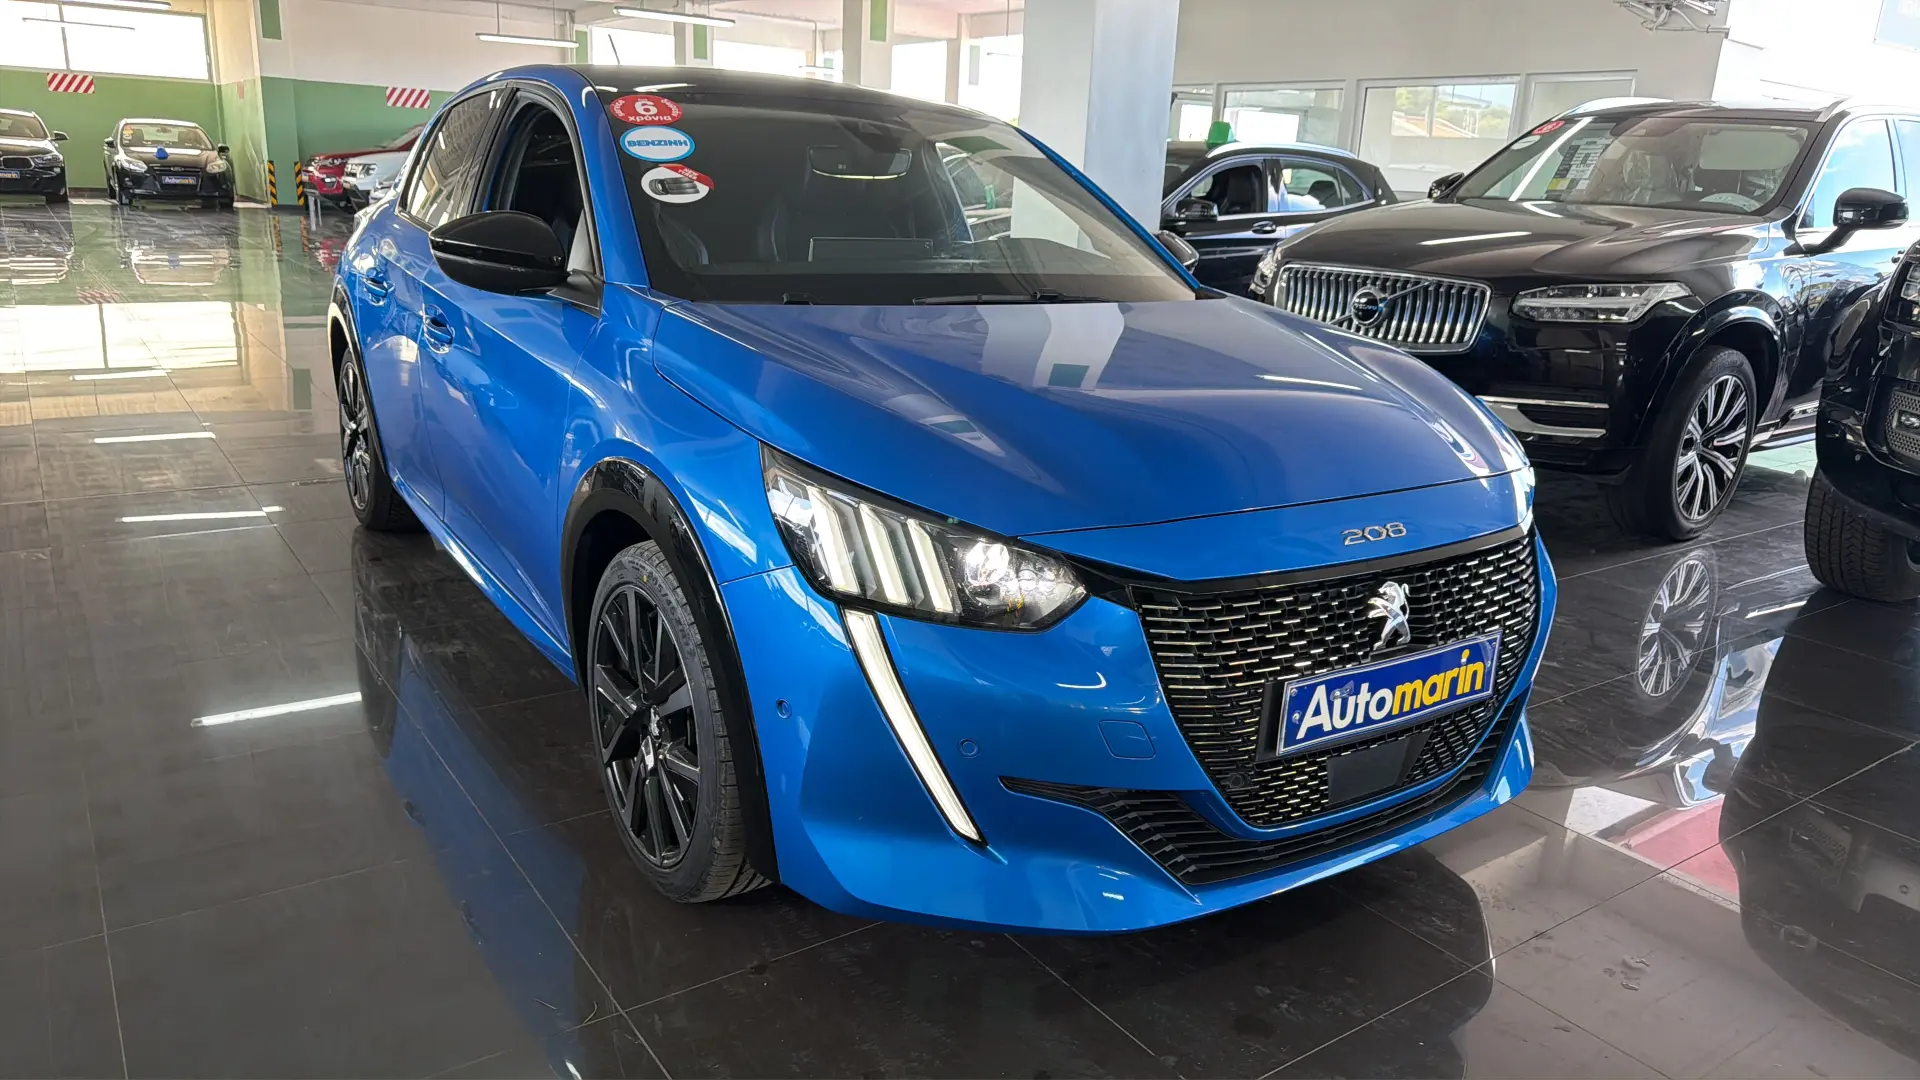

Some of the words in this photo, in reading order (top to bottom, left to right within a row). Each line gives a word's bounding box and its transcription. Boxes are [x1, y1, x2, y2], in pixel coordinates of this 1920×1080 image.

[634, 101, 658, 115] 6
[1341, 522, 1407, 546] 208
[1296, 648, 1484, 741] Automarin
